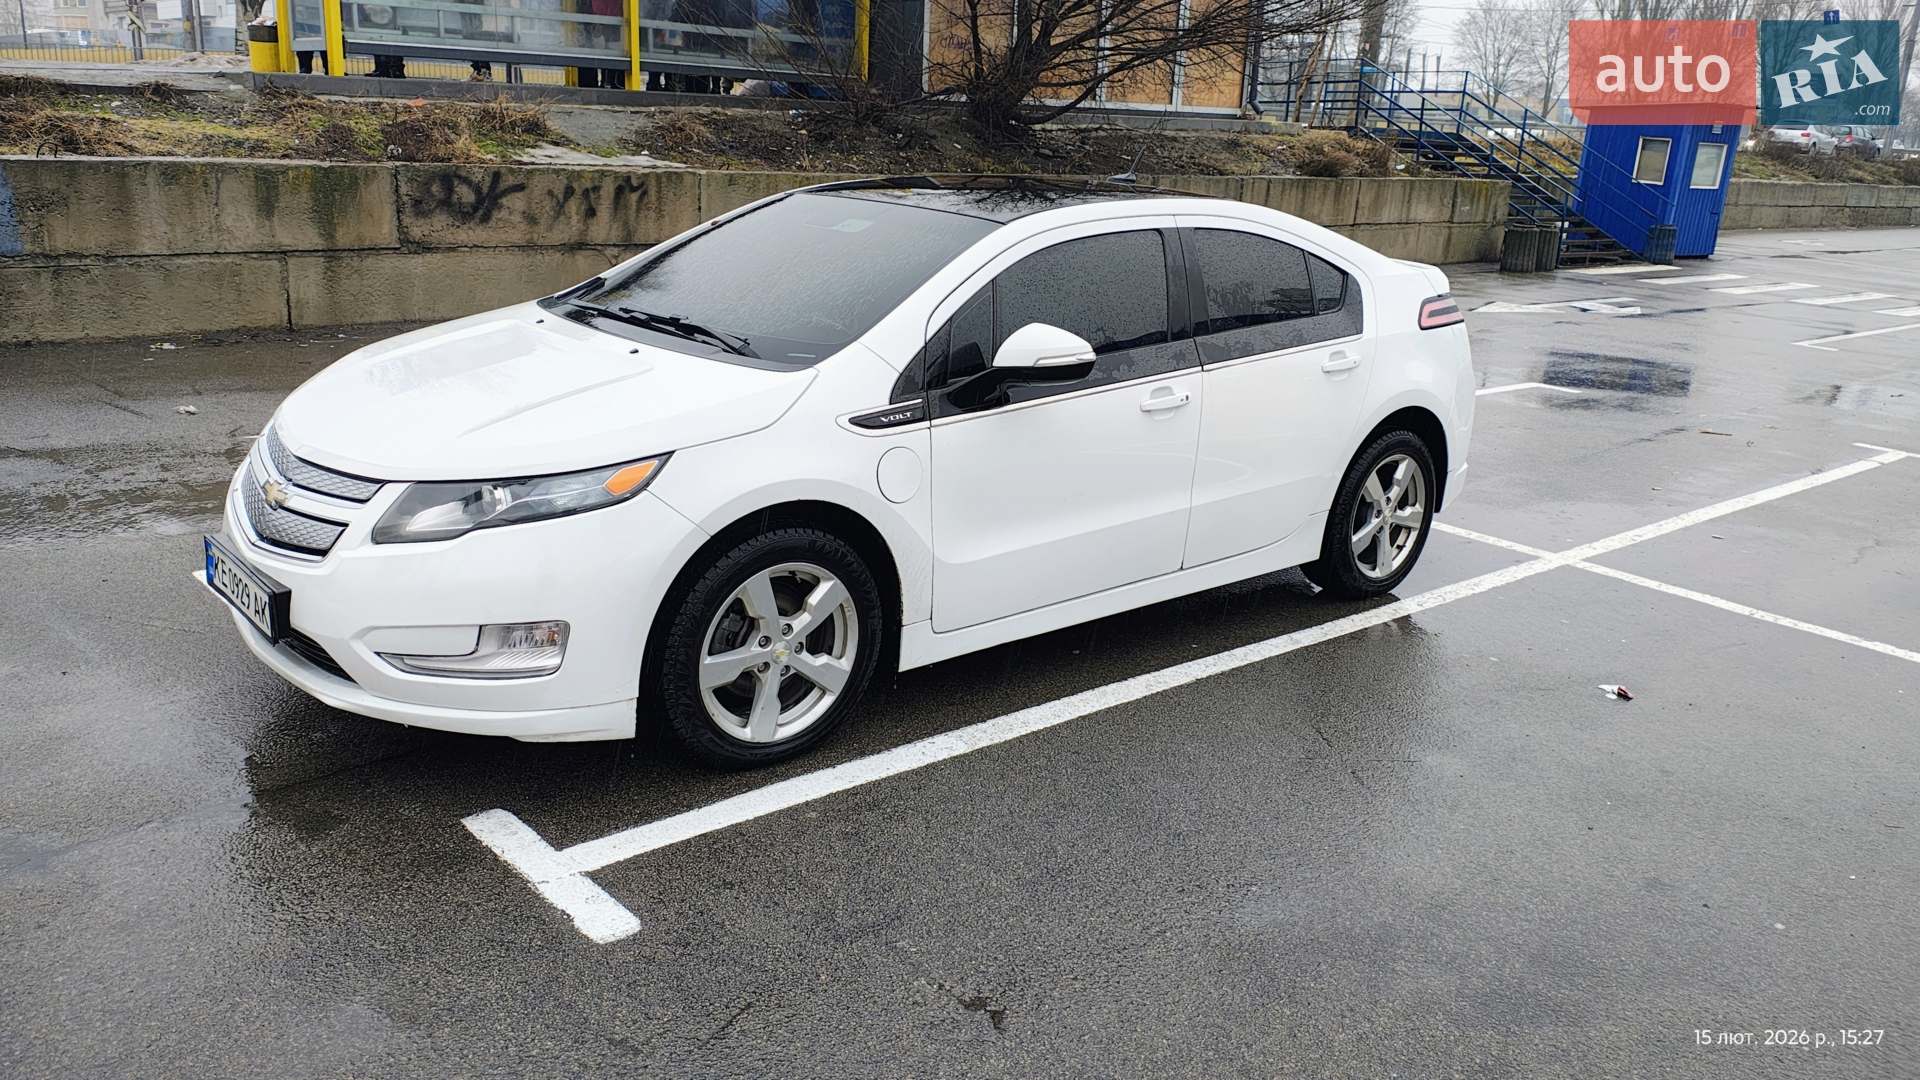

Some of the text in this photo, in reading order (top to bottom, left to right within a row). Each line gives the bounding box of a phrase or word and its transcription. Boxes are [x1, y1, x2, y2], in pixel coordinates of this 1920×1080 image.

[880, 411, 913, 422] VOLT
[215, 556, 270, 630] KE 0929 AK
